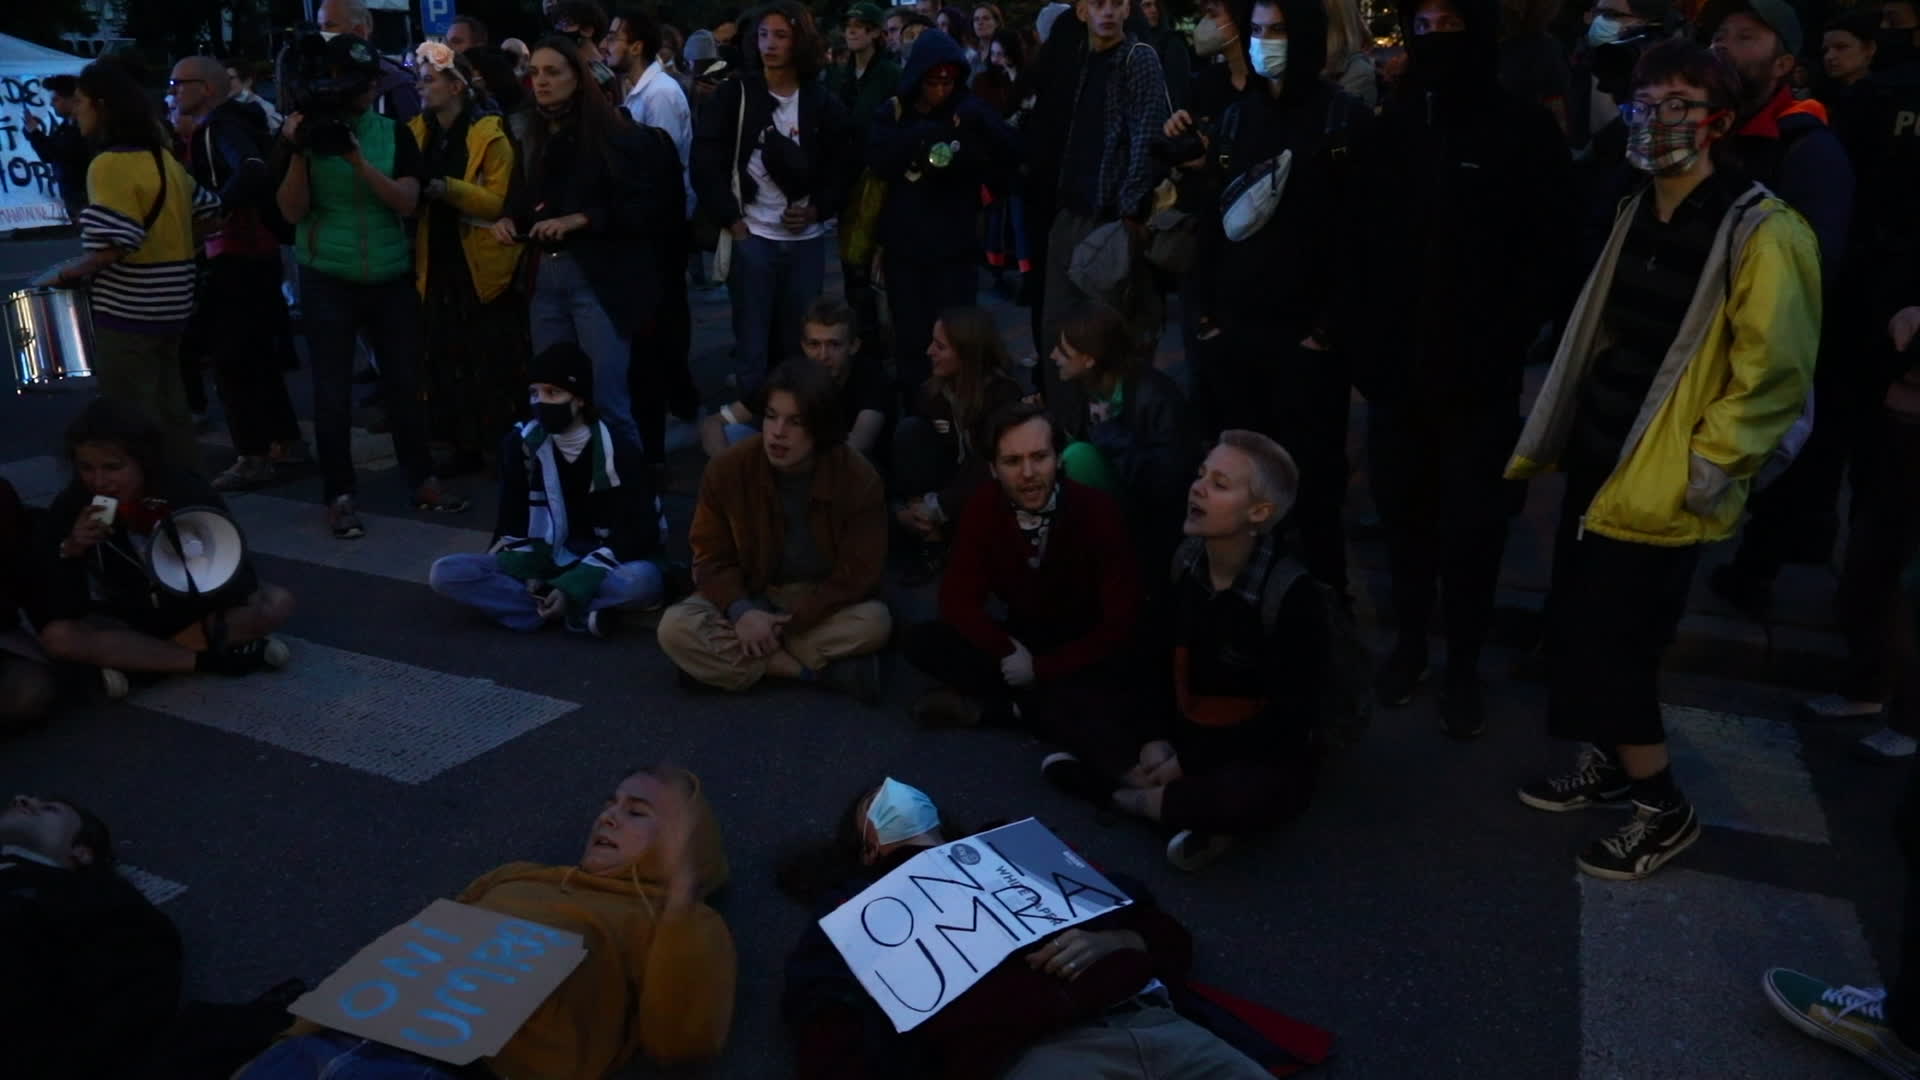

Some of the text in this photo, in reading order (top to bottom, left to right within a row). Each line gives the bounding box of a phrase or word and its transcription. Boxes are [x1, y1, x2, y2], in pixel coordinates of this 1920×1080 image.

[429, 0, 448, 22] P
[0, 77, 46, 107] DE
[861, 841, 1025, 947] ONI
